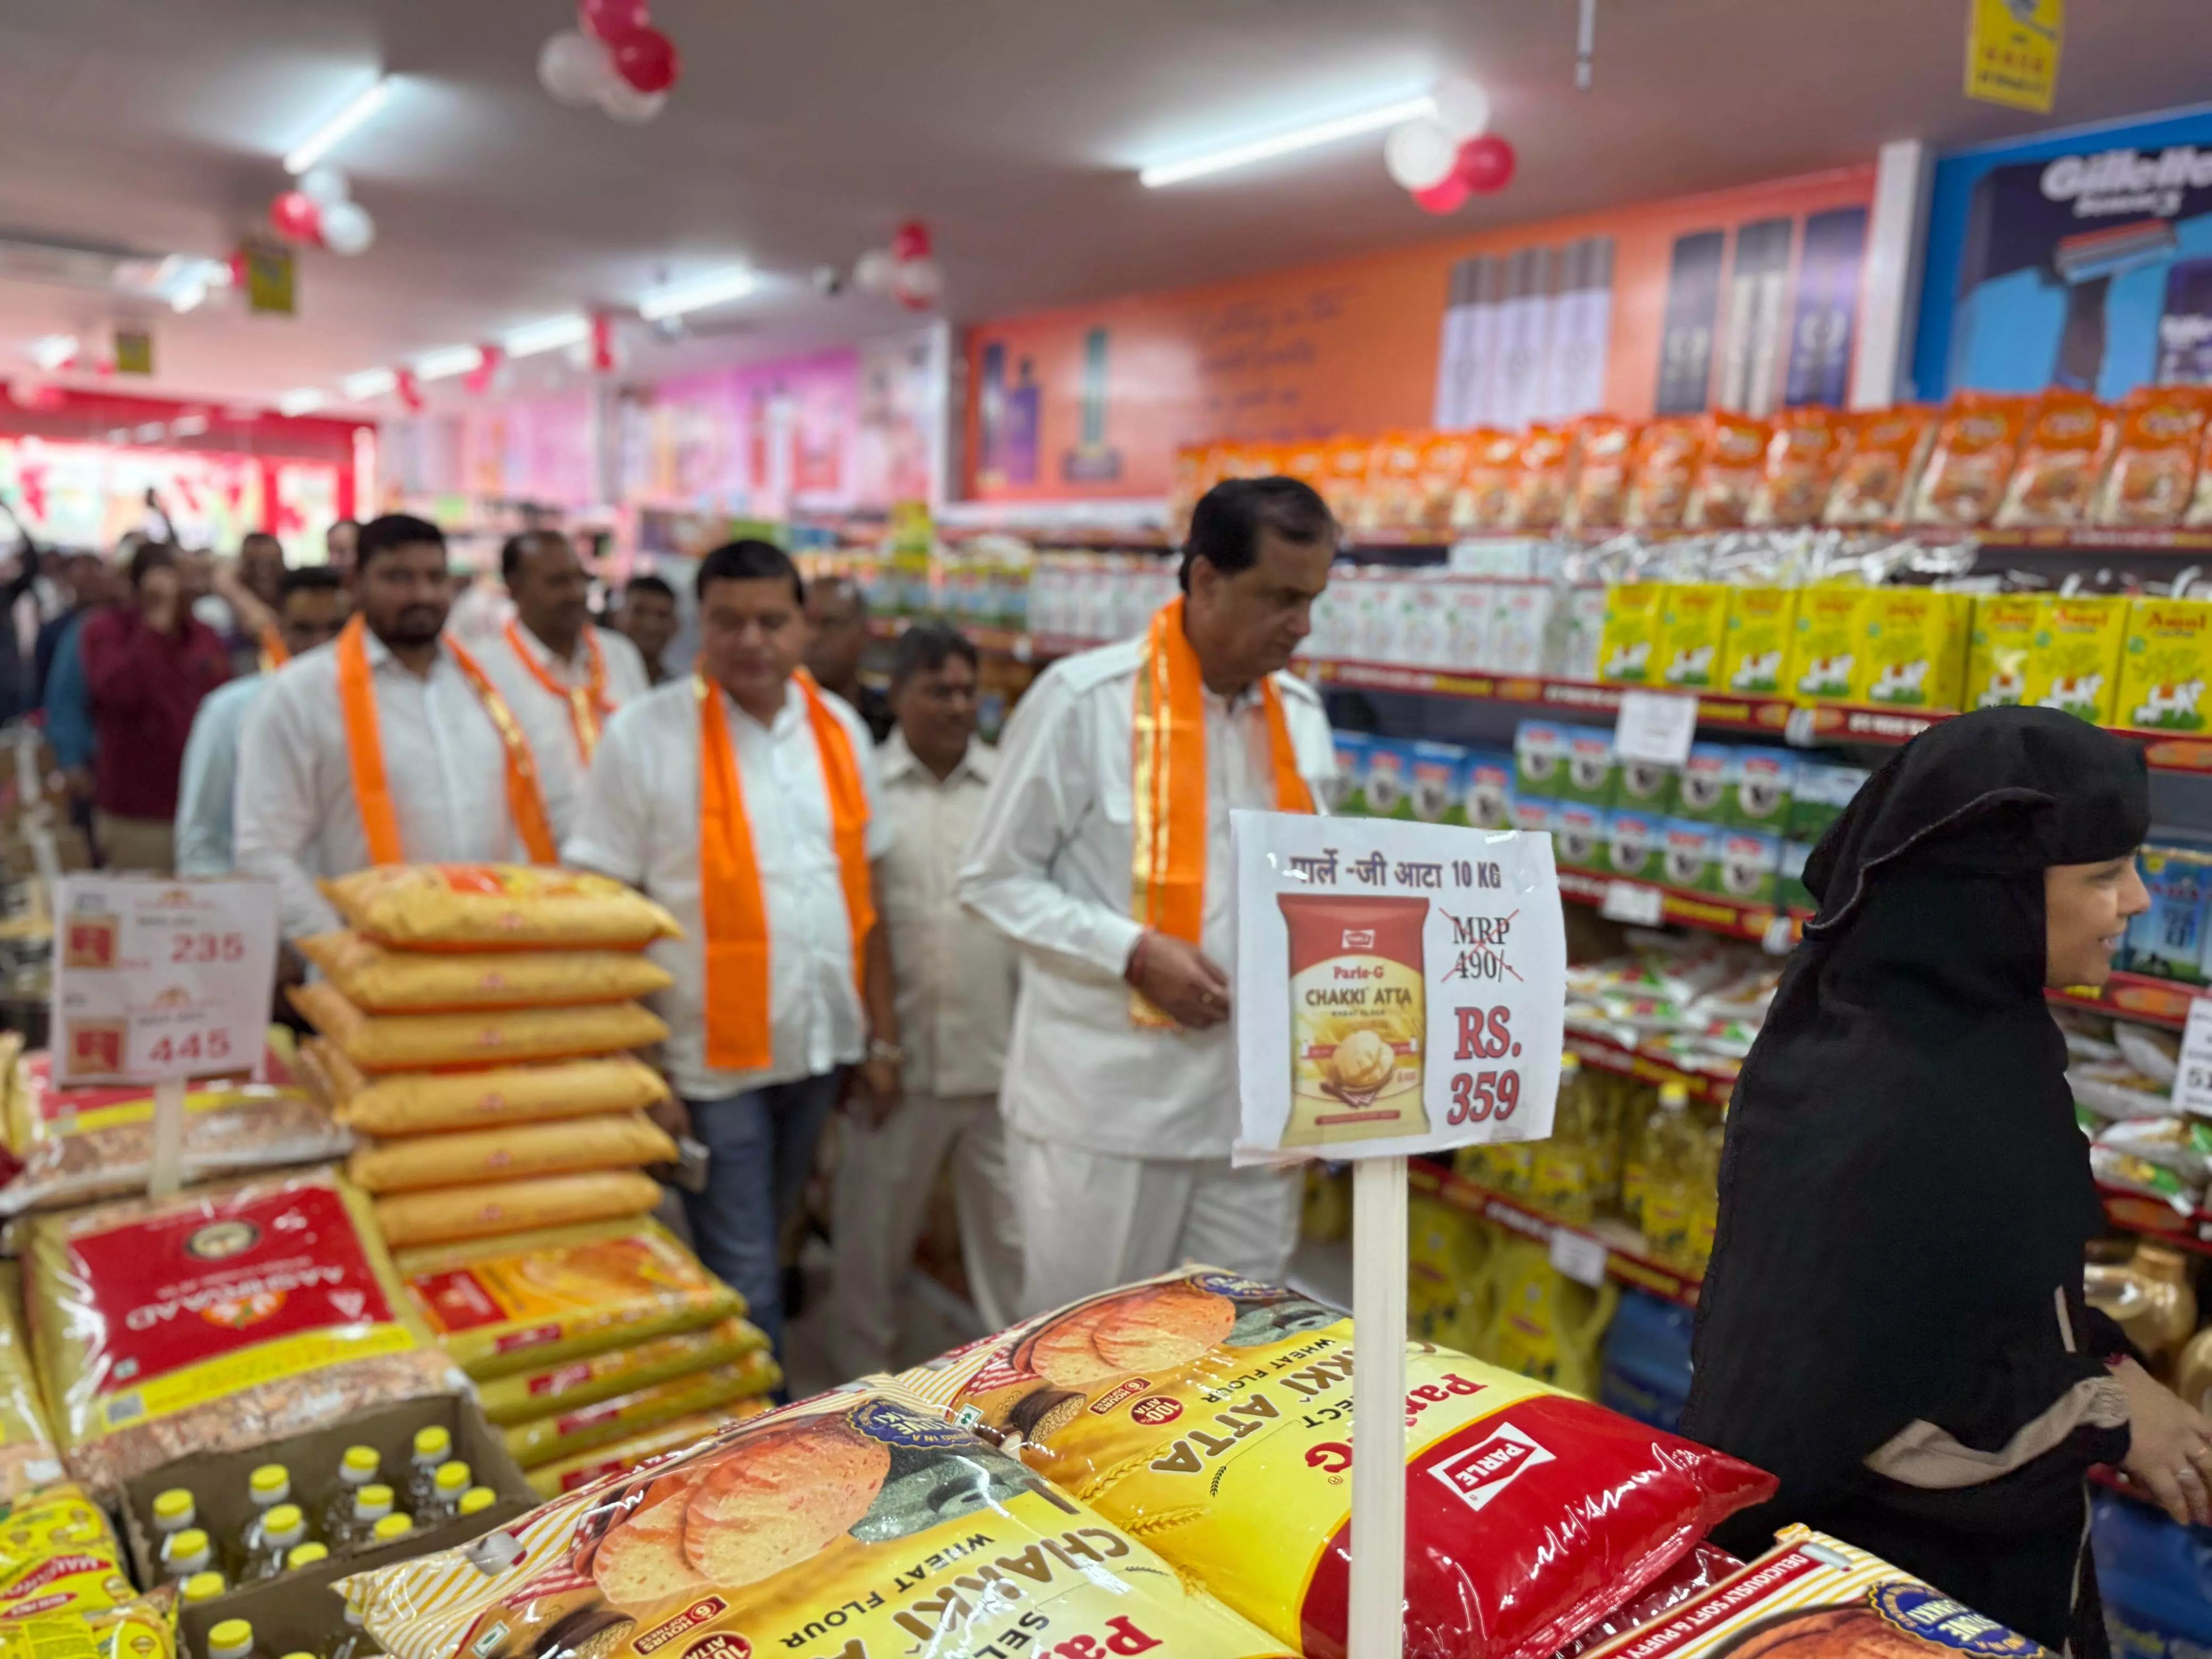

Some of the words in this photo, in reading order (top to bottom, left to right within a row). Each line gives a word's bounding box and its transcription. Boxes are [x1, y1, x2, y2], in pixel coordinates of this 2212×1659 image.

[1394, 861, 1443, 889] आटा
[1452, 860, 1473, 887] 10
[1478, 861, 1502, 888] KG
[1452, 916, 1510, 945] MRP
[1333, 965, 1385, 979] Parle-G
[1305, 988, 1365, 1006] CHAKKI
[1374, 987, 1412, 1005] ATTA
[148, 1027, 231, 1063] 445
[1454, 1005, 1522, 1060] RS.
[1446, 1069, 1520, 1126] 359
[1269, 1338, 1337, 1370] WHEAT
[1099, 1390, 1131, 1412] HOURS
[1200, 1369, 1269, 1404] FLOUR
[1134, 1397, 1161, 1414] ATTA
[1141, 1401, 1180, 1423] 100%
[1151, 1393, 1279, 1473] ATTA
[1455, 1443, 1526, 1487] PARLE
[894, 1532, 996, 1594] WHEAT
[1722, 1553, 1809, 1605] DELICIOUSLY
[779, 1590, 886, 1648] FLOUR
[1688, 1599, 1729, 1627] SOFT
[638, 1614, 689, 1646] SOFTNESS
[643, 1619, 694, 1652] HOURS
[1626, 1627, 1681, 1659] PUFFY
